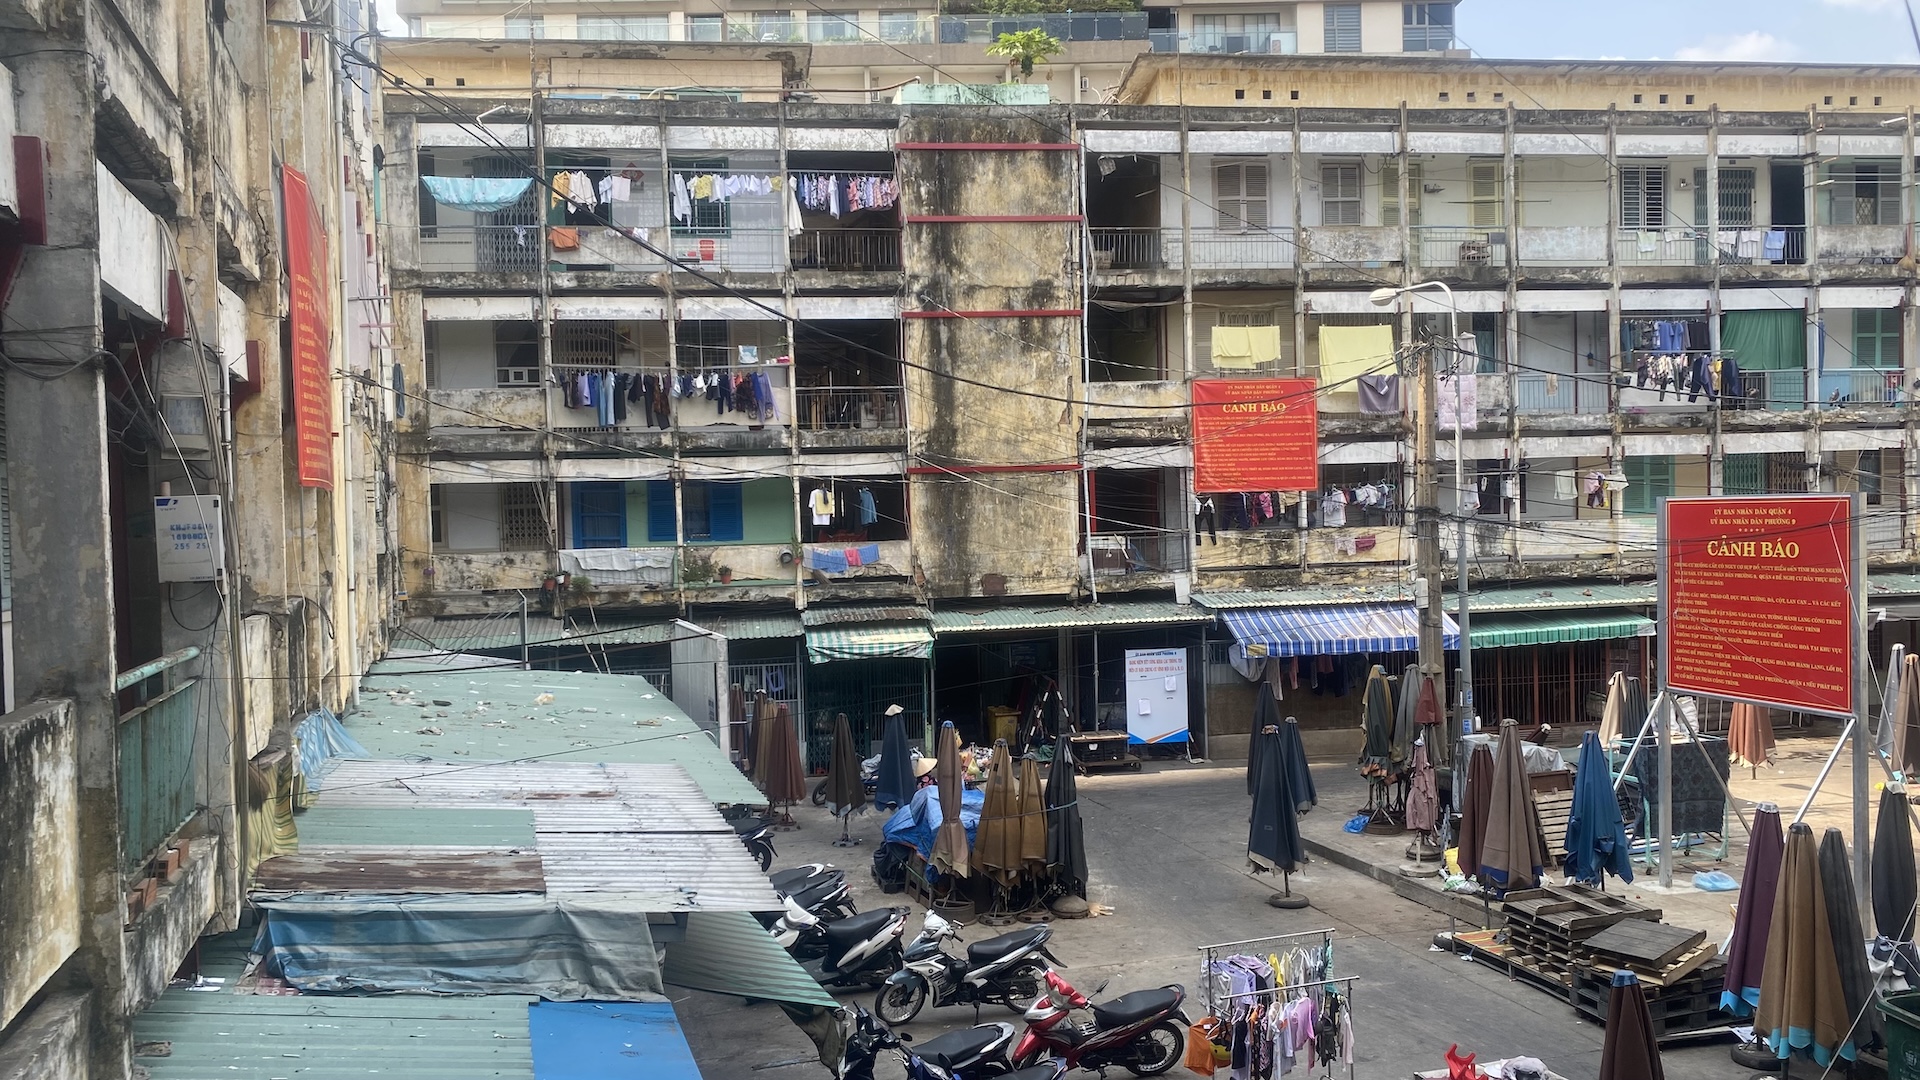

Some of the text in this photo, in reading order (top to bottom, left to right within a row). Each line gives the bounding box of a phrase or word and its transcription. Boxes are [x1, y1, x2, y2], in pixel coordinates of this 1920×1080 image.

[1260, 401, 1286, 412] BÁO
[1768, 508, 1787, 516] QUẬN
[1707, 535, 1800, 559] CẢNH BÁO
